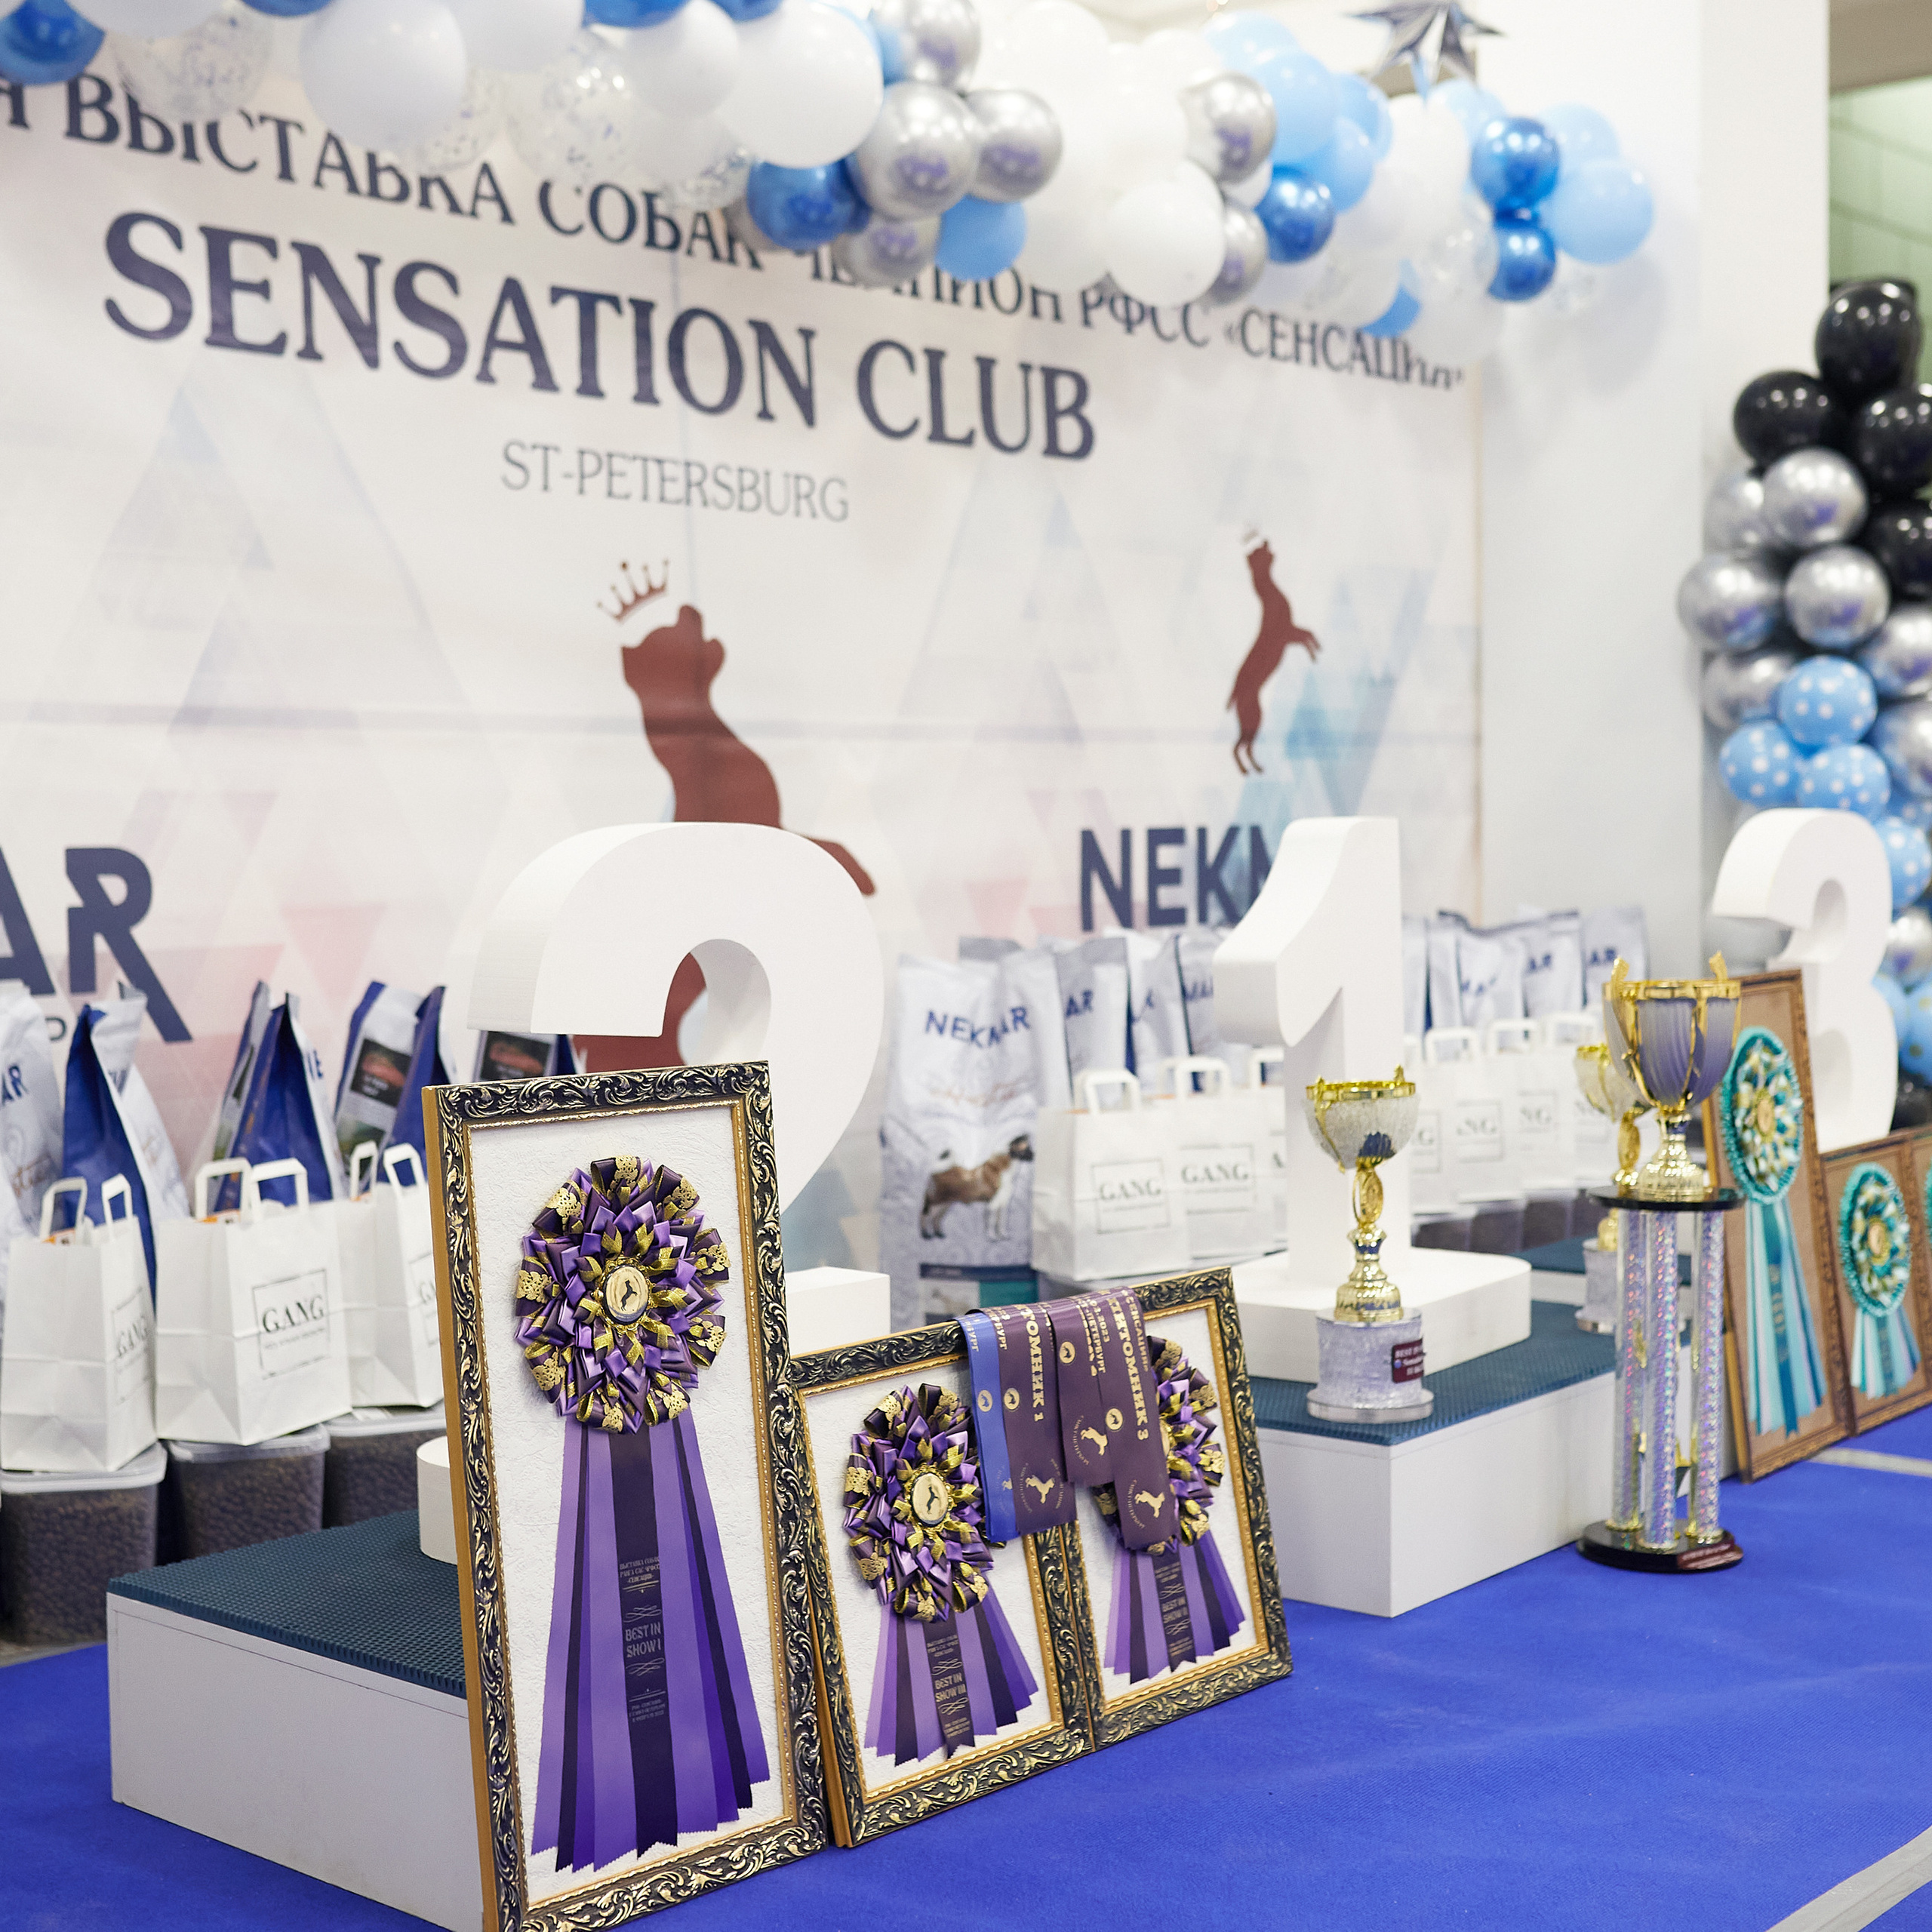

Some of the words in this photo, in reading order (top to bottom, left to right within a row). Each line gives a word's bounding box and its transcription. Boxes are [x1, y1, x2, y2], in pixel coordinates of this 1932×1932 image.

[104, 211, 817, 429] SENSATION
[857, 339, 1094, 460] CLUB
[501, 438, 849, 522] ST-PETERSBURG
[1180, 1163, 1249, 1183] GANG
[1099, 1178, 1161, 1201] GANG
[262, 1294, 325, 1333] GANG
[626, 1624, 649, 1641] BEST
[650, 1622, 661, 1635] IN
[626, 1639, 656, 1658] SHOW
[935, 1676, 953, 1690] BEST
[935, 1687, 958, 1703] SHOW
